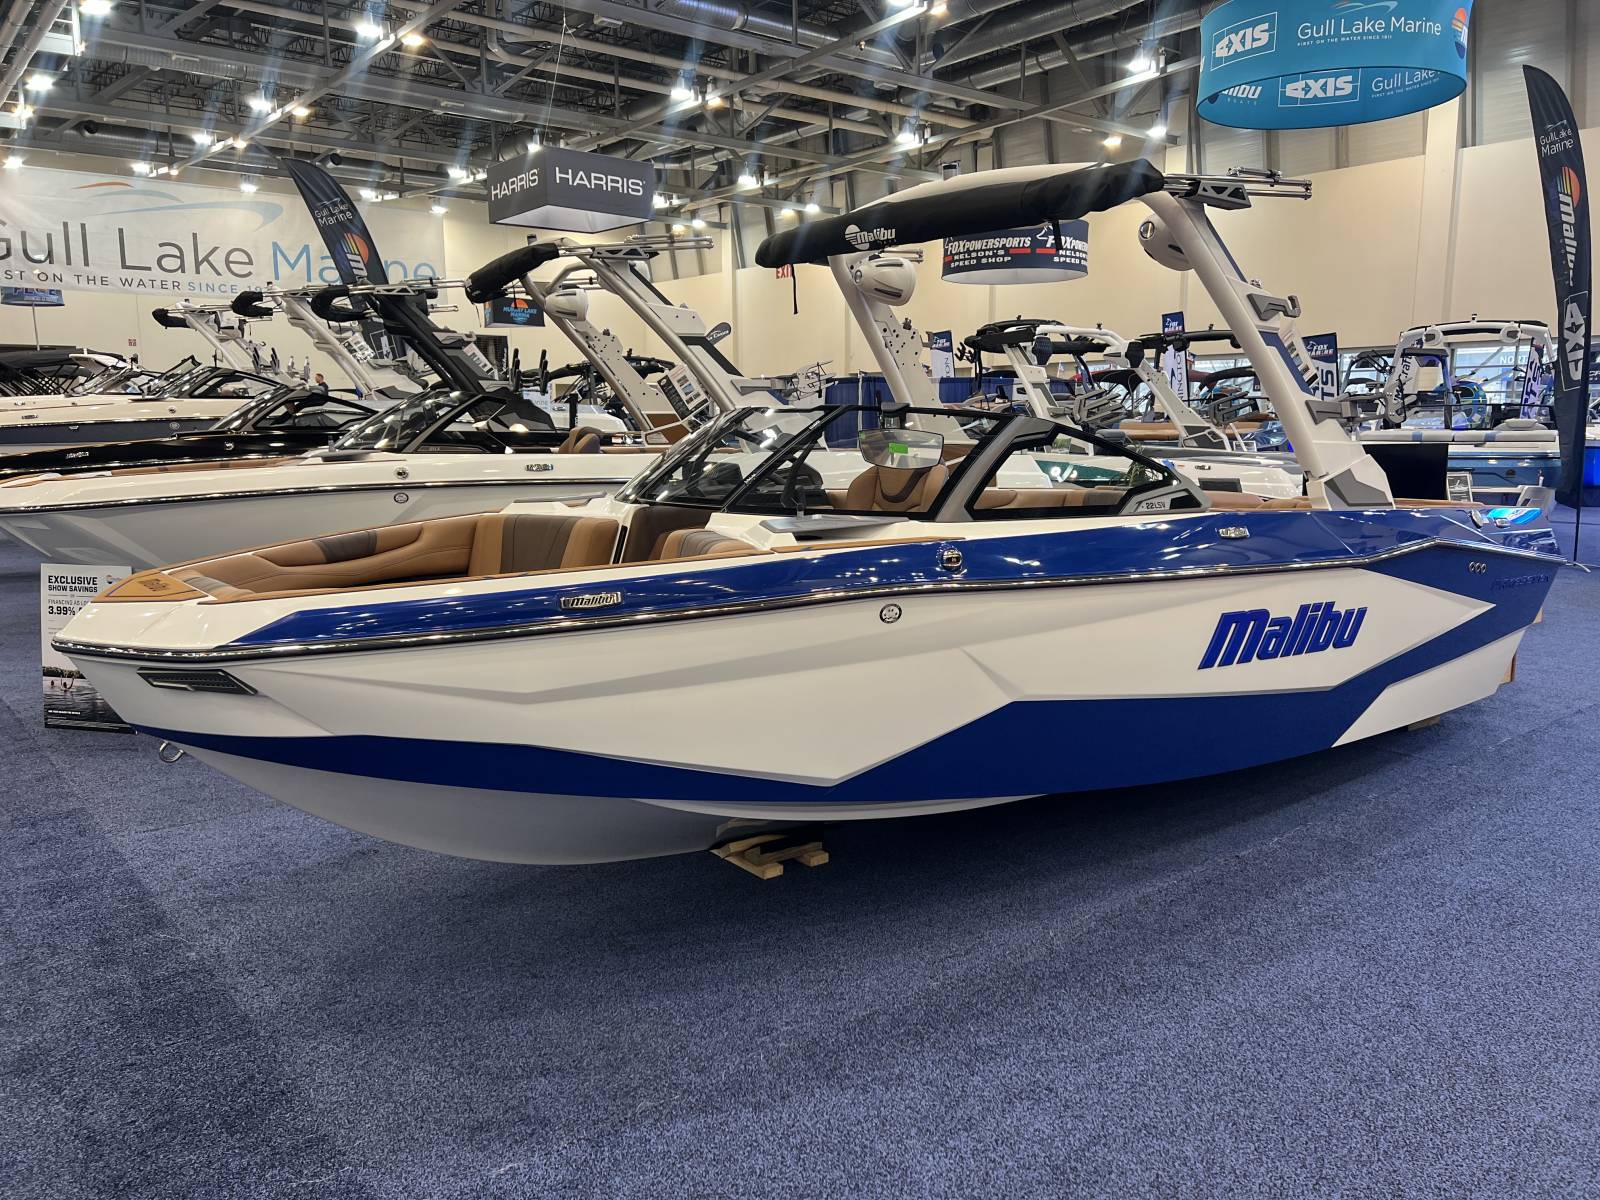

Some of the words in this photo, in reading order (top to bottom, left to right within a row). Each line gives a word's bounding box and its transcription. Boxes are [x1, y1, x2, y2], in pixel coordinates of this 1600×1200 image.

[1297, 18, 1335, 39] Gull
[1341, 16, 1386, 34] Lake
[1391, 16, 1442, 36] Marine
[1371, 72, 1401, 92] Gull
[1405, 70, 1436, 85] Lake
[1540, 134, 1554, 146] Gull
[1554, 128, 1572, 141] Lake
[1541, 139, 1574, 158] Marine
[491, 169, 540, 200] HARRIS
[555, 167, 645, 196] HARRIS
[314, 207, 330, 218] Gull
[330, 203, 349, 214] Lake
[318, 211, 353, 227] Marine
[0, 219, 90, 267] ull
[117, 227, 254, 278] Lake
[271, 240, 437, 285] Mane
[950, 260, 977, 268] SPEED
[981, 256, 1011, 264] SHOP
[1053, 256, 1080, 264] SPEED
[37, 271, 63, 283] ON
[74, 274, 110, 286] THE
[119, 277, 181, 291] WATER
[187, 281, 238, 294] SINCE
[1313, 344, 1328, 352] FOX
[48, 575, 98, 585] EXCLUSIVE
[48, 584, 68, 592] SHOW
[48, 606, 76, 616] 3.99%
[1198, 601, 1368, 670] Malibu
